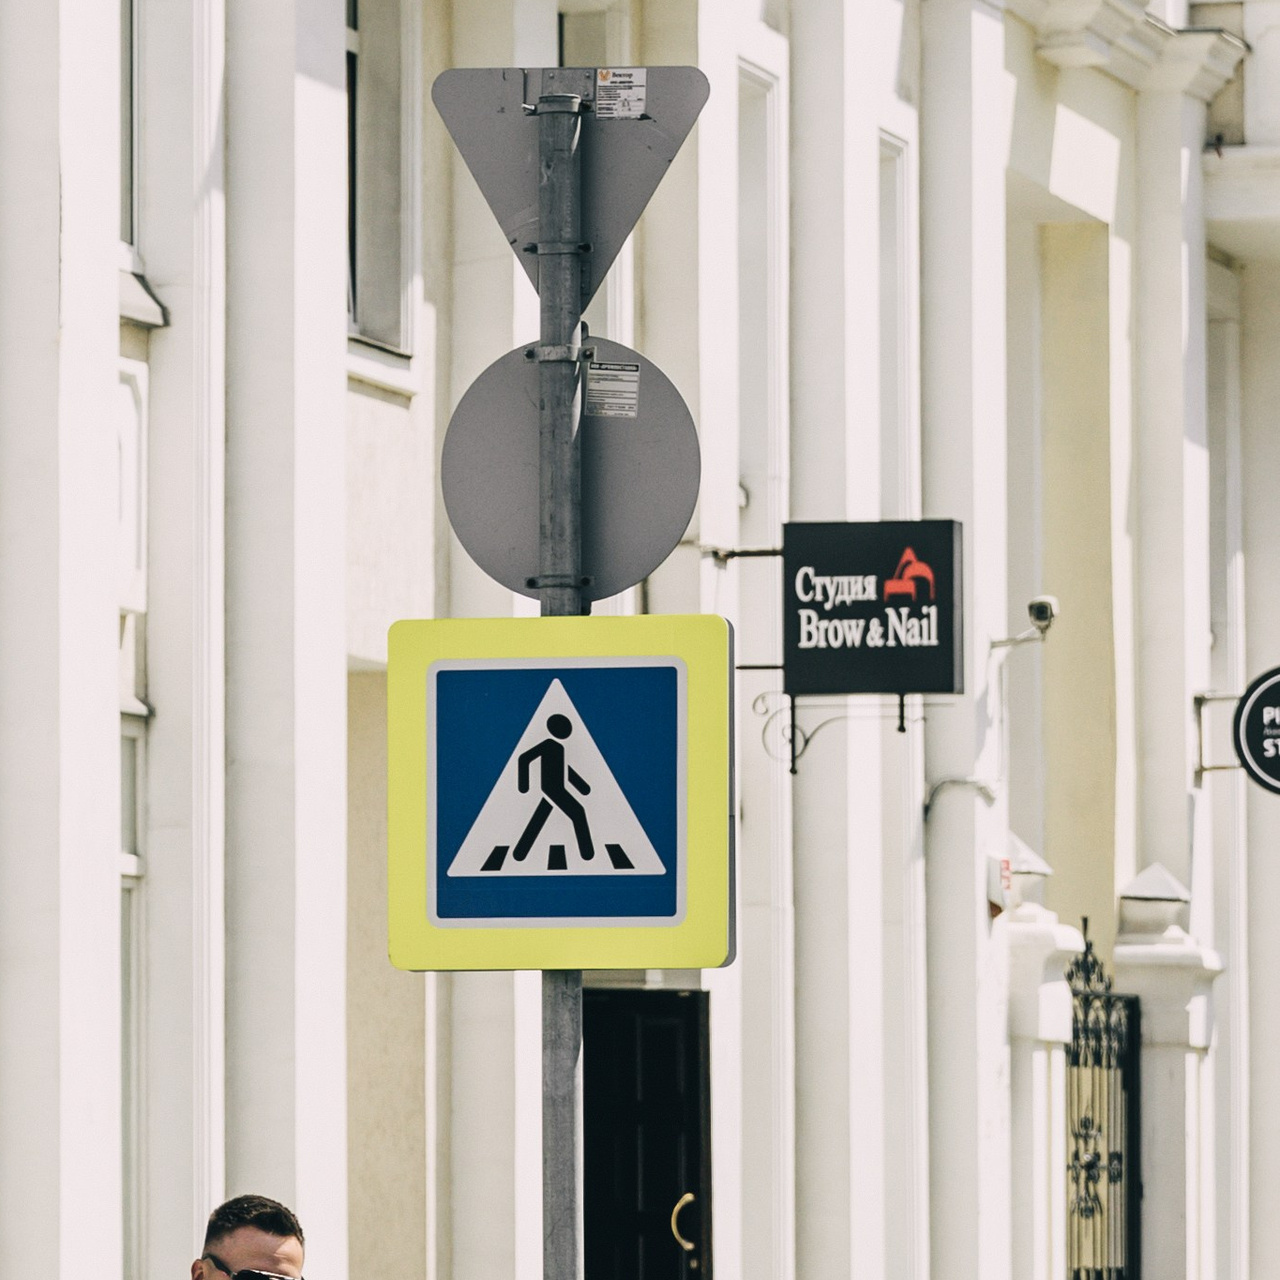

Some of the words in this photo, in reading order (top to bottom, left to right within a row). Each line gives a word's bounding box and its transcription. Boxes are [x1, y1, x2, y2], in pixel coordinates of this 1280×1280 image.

[794, 566, 878, 611] Студия
[797, 608, 866, 649] Brow
[865, 617, 885, 648] &
[884, 604, 940, 648] Nail
